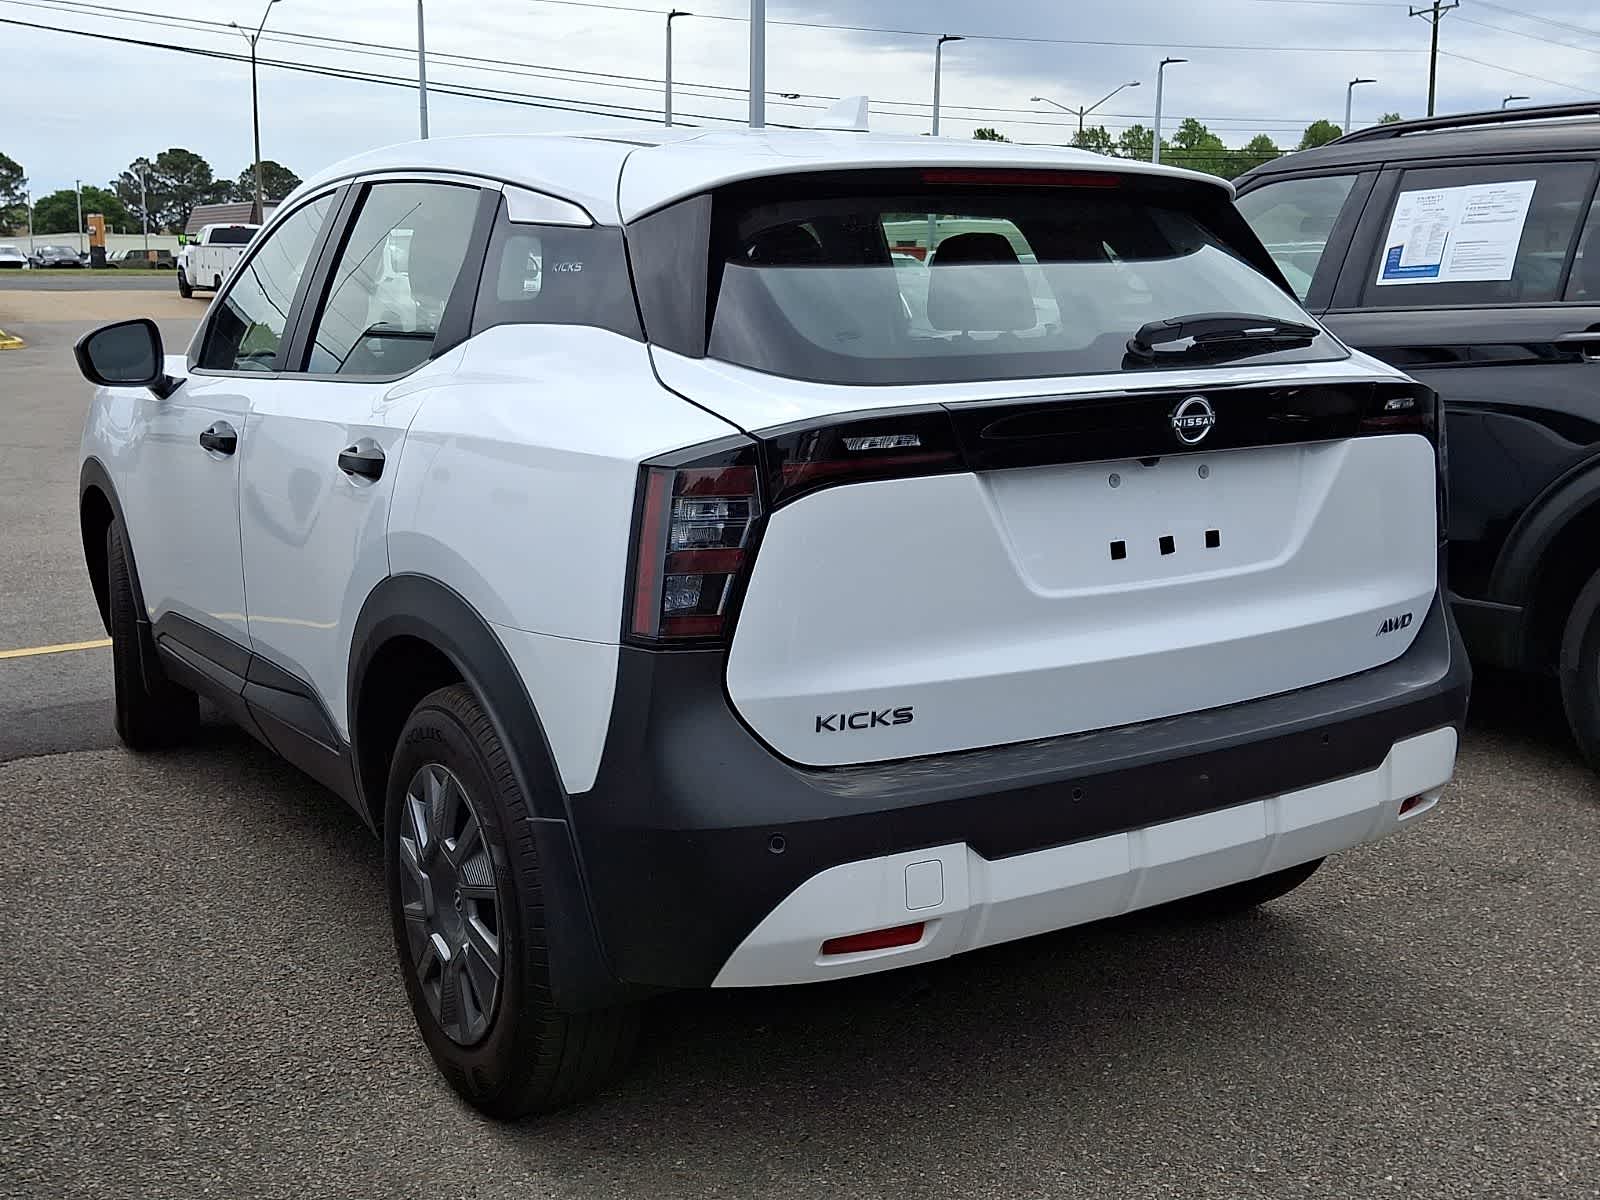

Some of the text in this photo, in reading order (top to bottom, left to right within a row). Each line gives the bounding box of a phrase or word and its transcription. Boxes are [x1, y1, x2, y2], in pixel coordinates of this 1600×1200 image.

[552, 262, 582, 272] KICKS
[1173, 414, 1215, 427] NISSAN
[1376, 612, 1412, 636] AWD
[815, 706, 914, 732] KICKS
